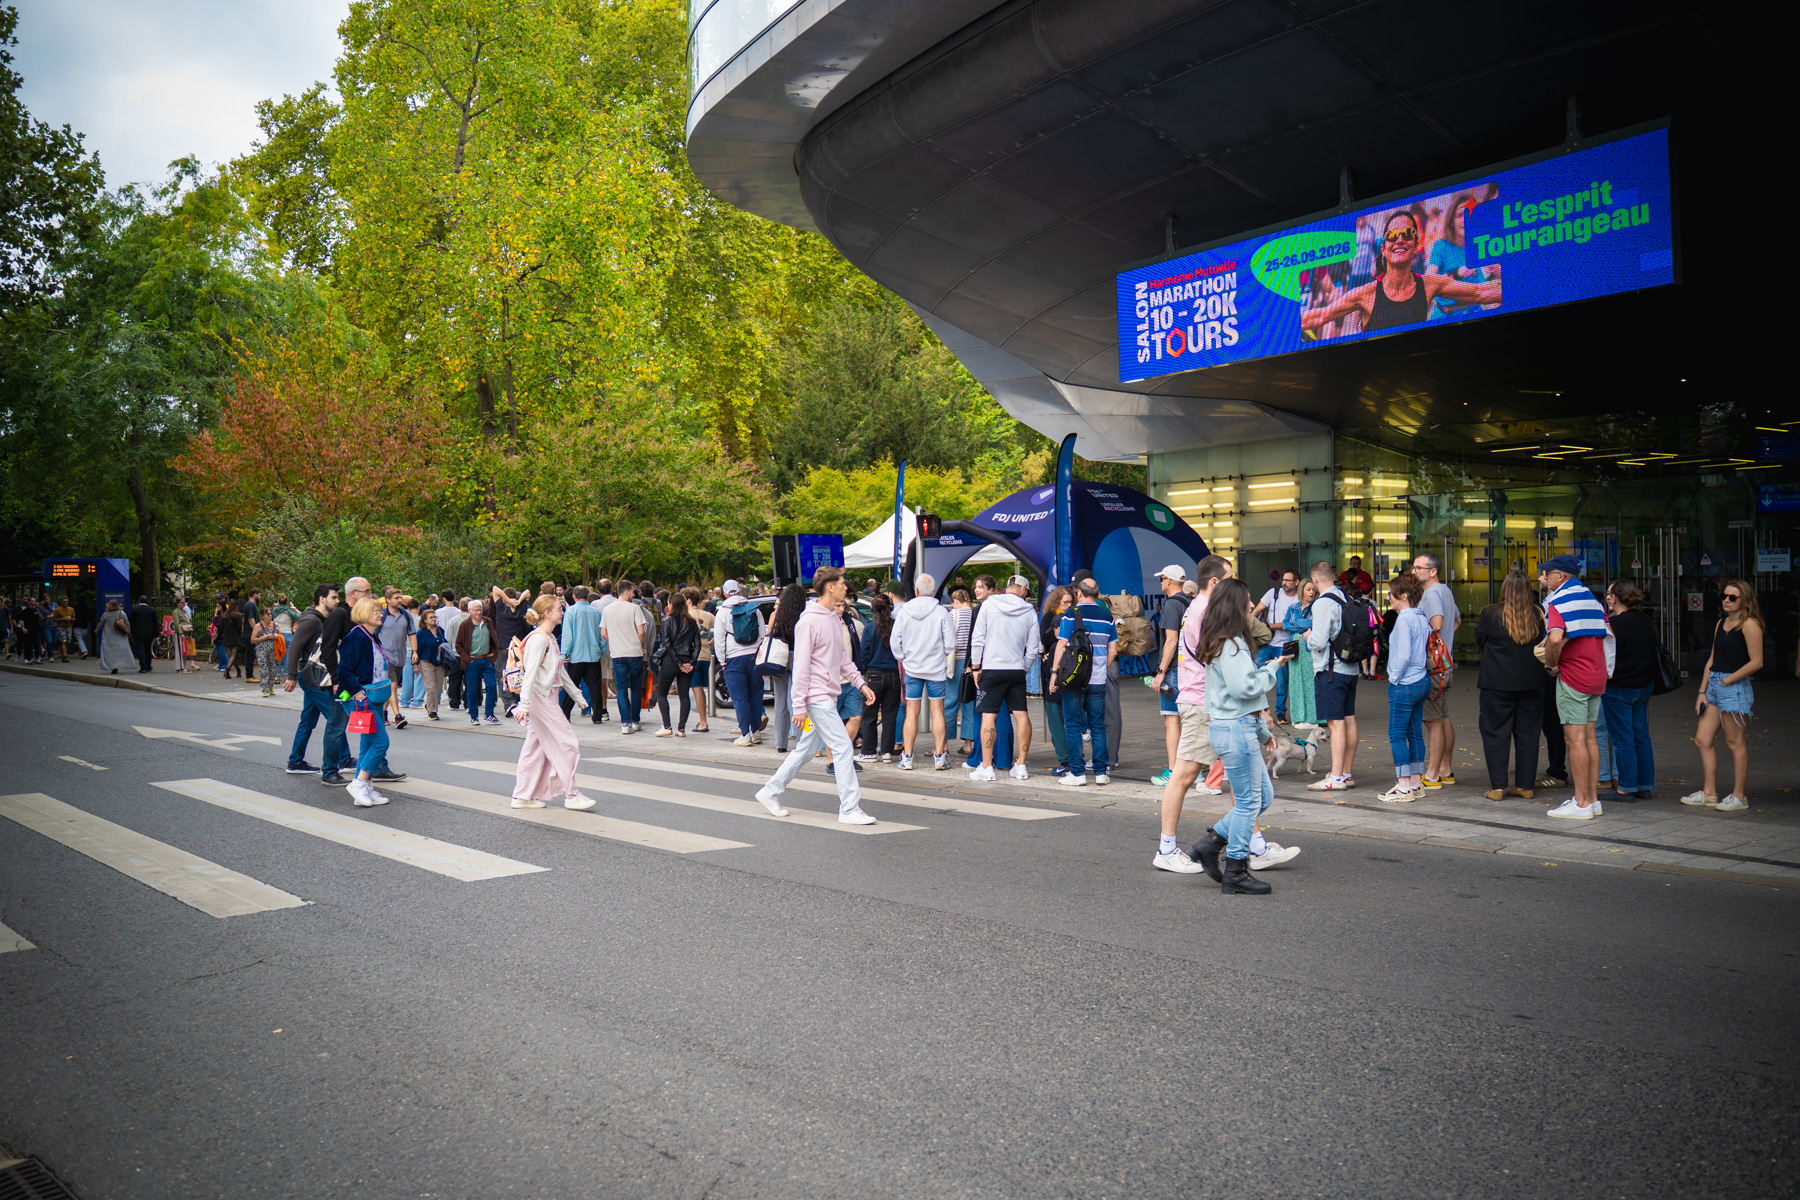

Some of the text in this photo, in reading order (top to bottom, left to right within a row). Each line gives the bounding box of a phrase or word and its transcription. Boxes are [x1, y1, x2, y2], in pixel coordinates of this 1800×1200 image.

[1502, 180, 1613, 229] L'esprit
[1473, 203, 1650, 260] Tourangeau
[1148, 260, 1237, 290] Harmonie Mutuelle
[1264, 241, 1351, 272] 25-26.09.2026
[1149, 272, 1237, 308] MARATHON
[1150, 305, 1174, 331] 10
[1193, 290, 1238, 323] 20K
[1135, 281, 1150, 363] SALON
[1151, 316, 1239, 360] TOURS
[991, 510, 1049, 523] FDJ UNITED
